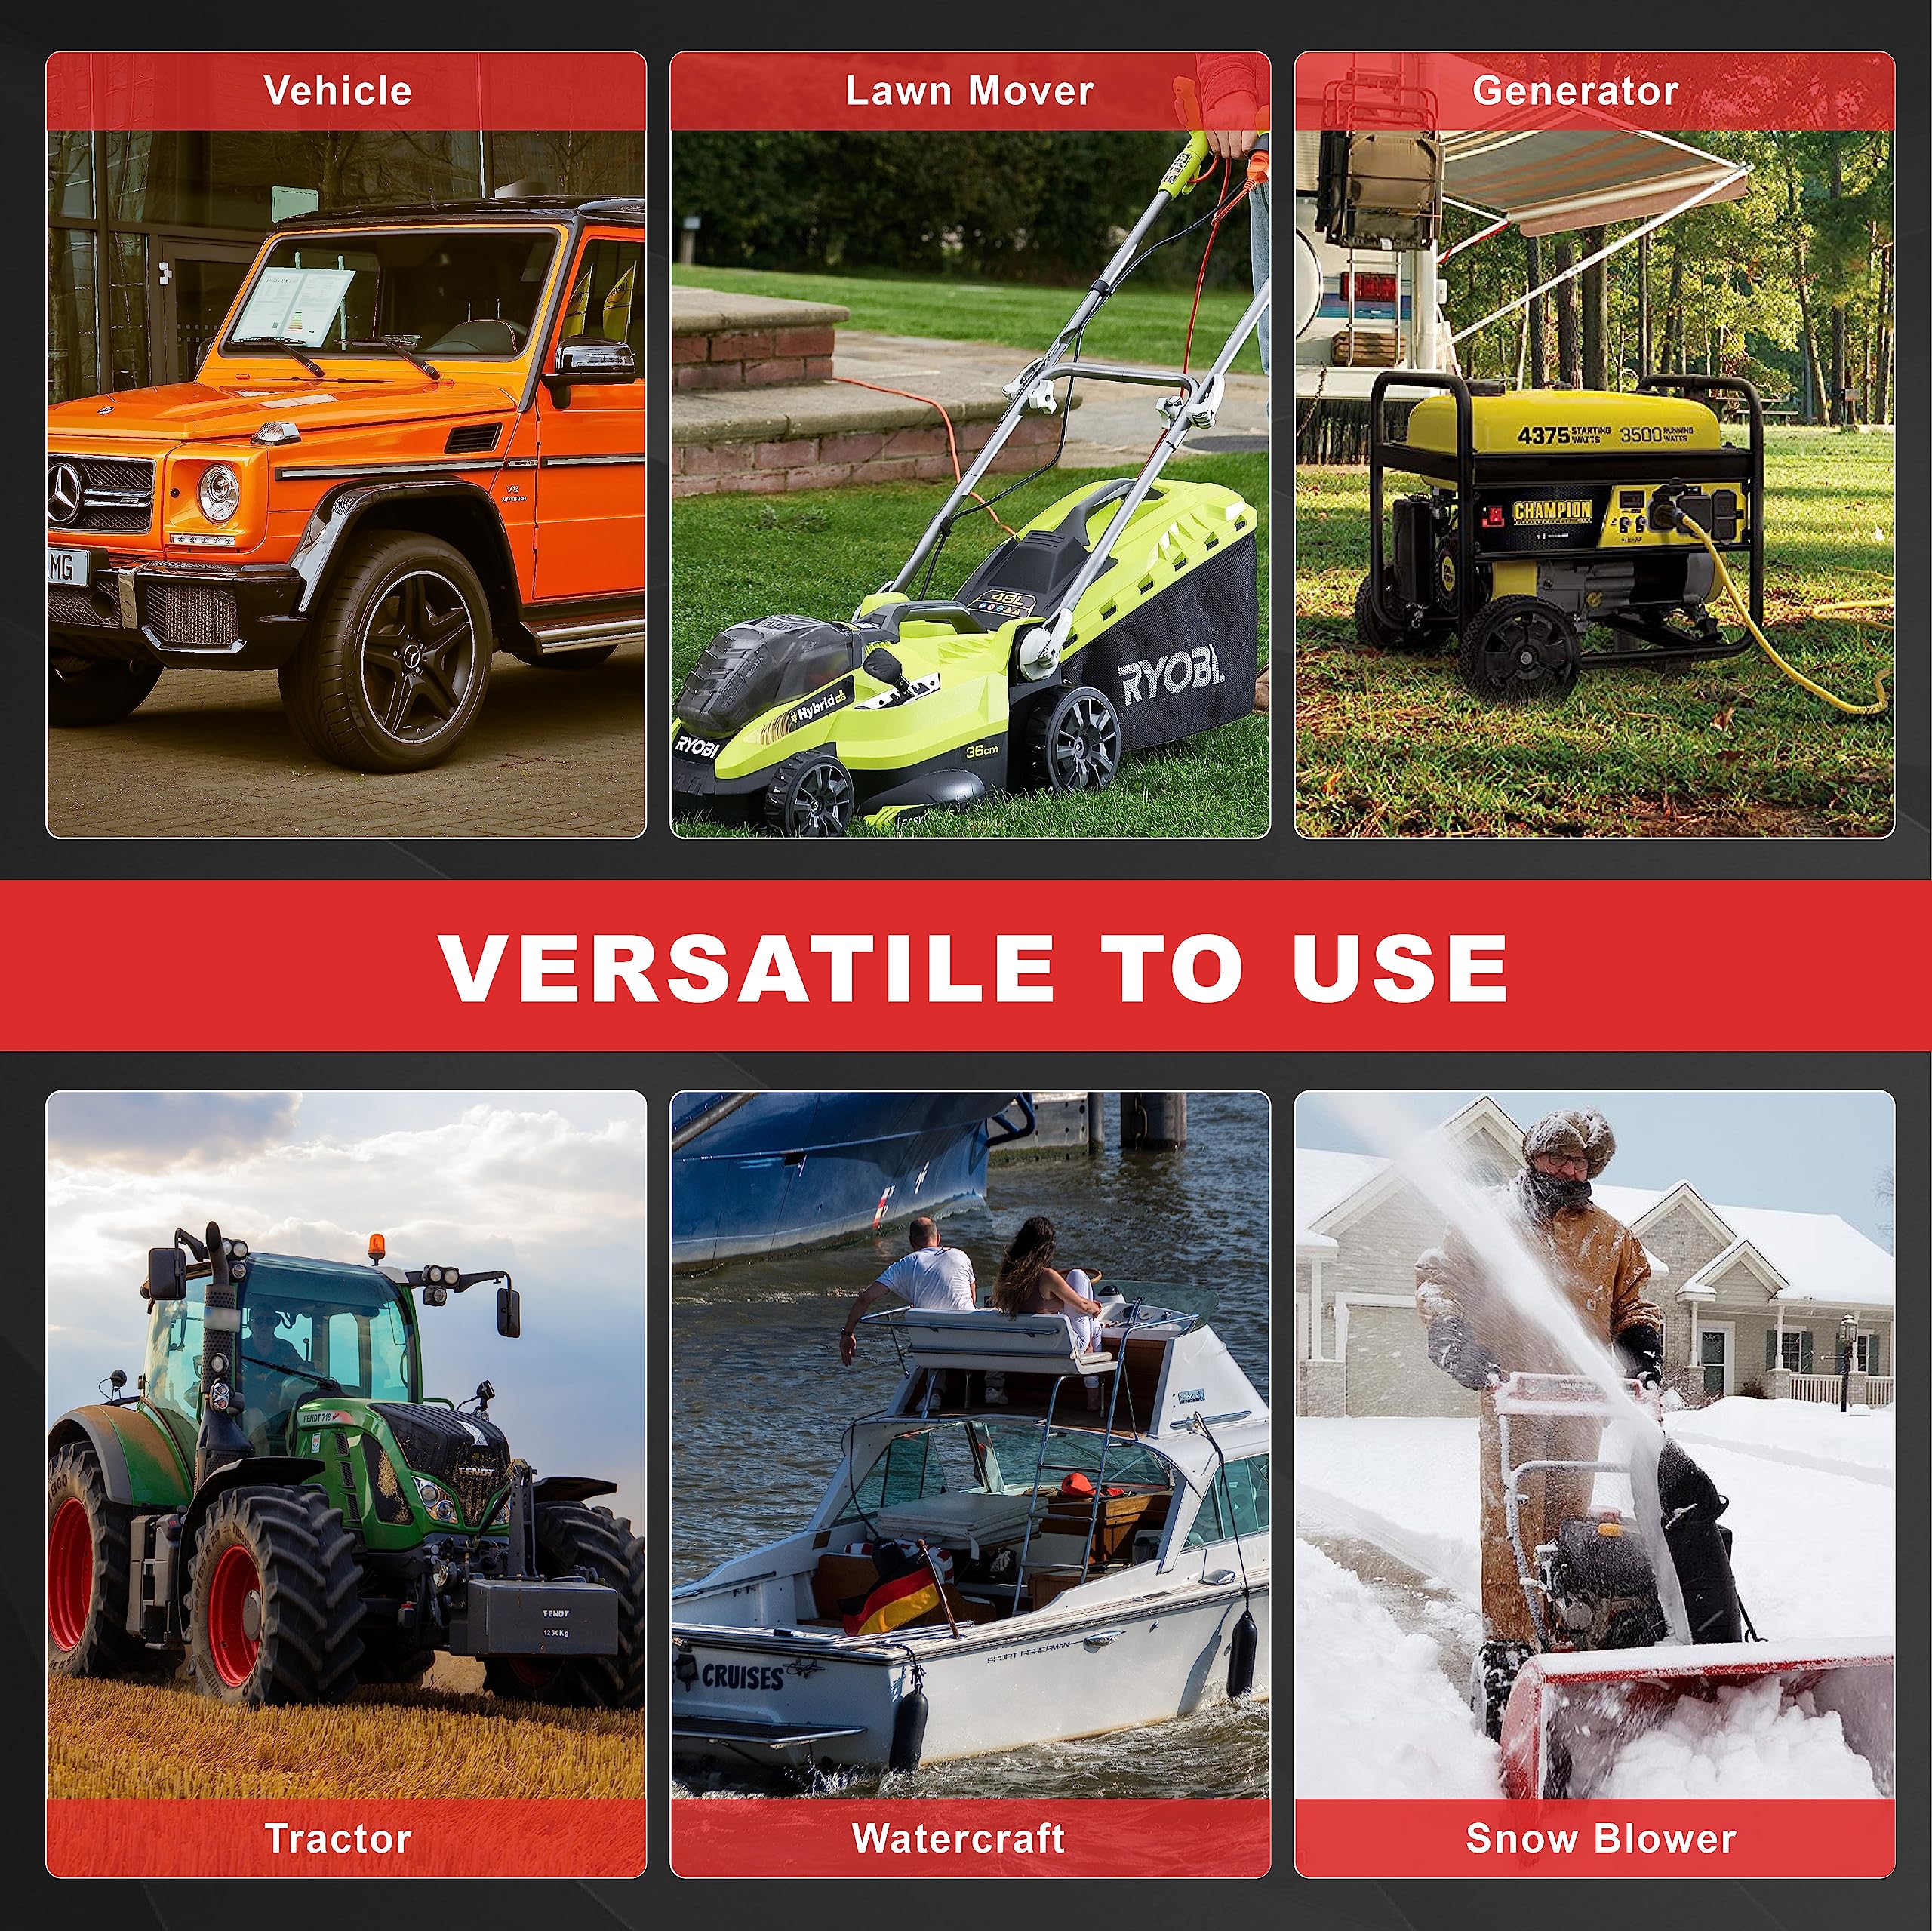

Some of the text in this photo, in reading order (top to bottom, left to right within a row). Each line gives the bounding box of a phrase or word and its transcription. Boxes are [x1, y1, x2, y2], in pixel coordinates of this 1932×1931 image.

[1518, 426, 1571, 444] 4375
[1571, 426, 1611, 435] STARTING
[1620, 426, 1661, 443] 3500
[1572, 435, 1601, 444] WATTS
[506, 485, 519, 494] V8
[1513, 500, 1592, 520] CHAMPION
[48, 552, 73, 580] MG
[1118, 643, 1220, 706] RYOBI
[796, 693, 835, 722] Hybrid
[674, 736, 720, 759] RYOBI
[966, 744, 998, 759] 36cm
[303, 1413, 321, 1423] FENDT
[321, 1413, 331, 1422] 718
[458, 1466, 496, 1477] FENDT
[543, 1609, 570, 1618] FENDT
[543, 1629, 569, 1638] 1250Kg
[702, 1663, 785, 1691] CRUISES
